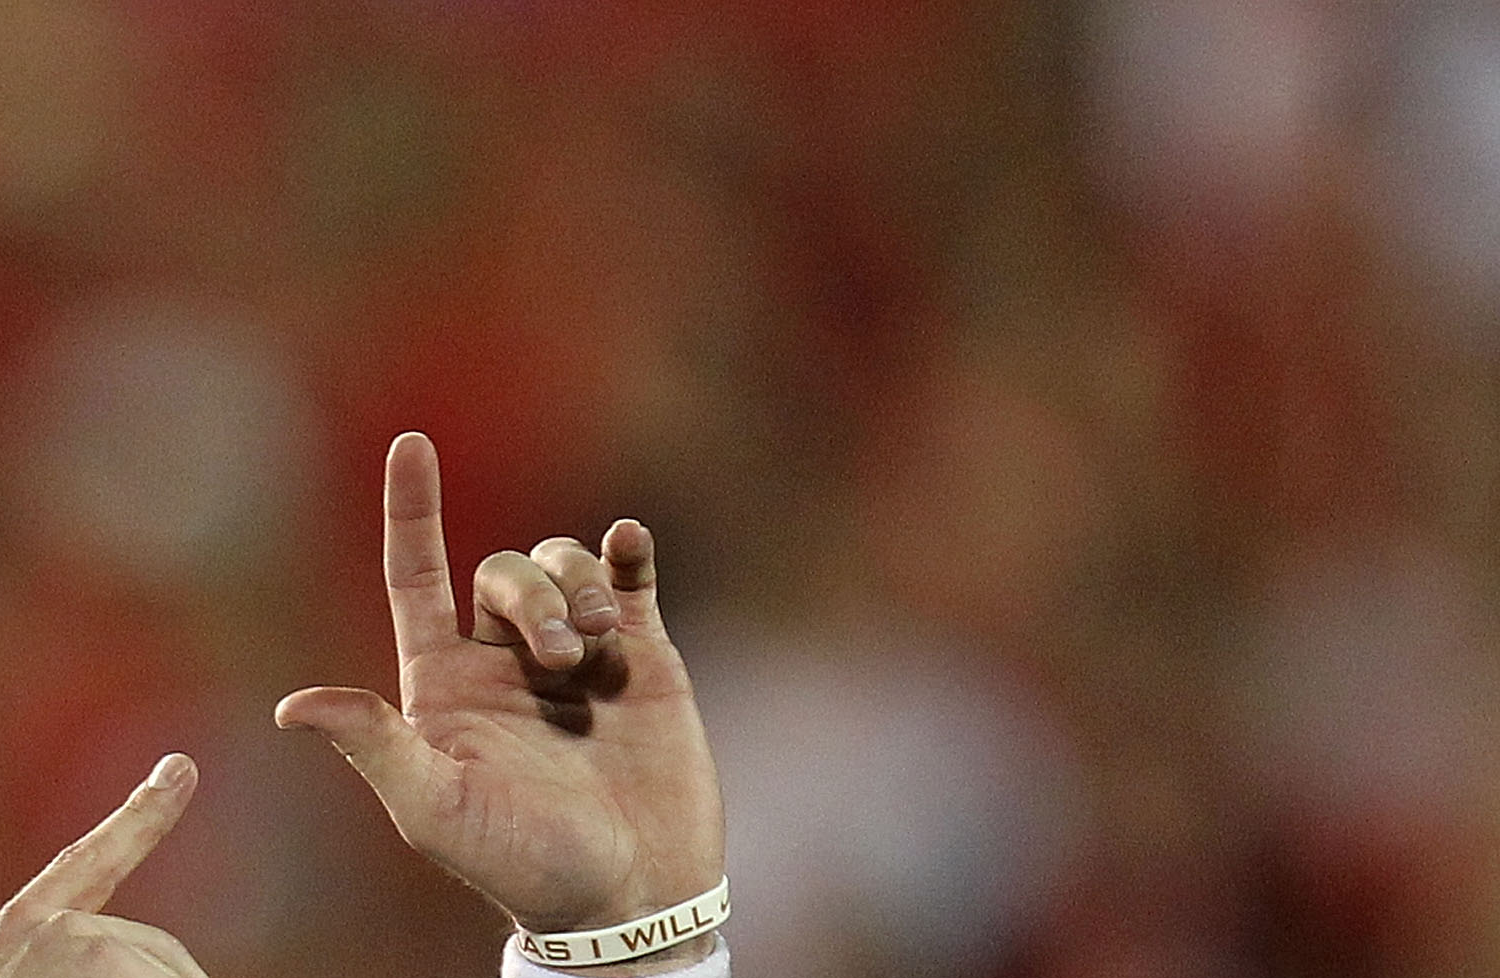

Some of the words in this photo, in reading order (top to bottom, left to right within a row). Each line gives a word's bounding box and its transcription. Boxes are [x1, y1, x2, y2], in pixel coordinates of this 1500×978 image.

[522, 936, 571, 961] AS
[592, 938, 602, 959] I
[619, 907, 713, 952] WILL
